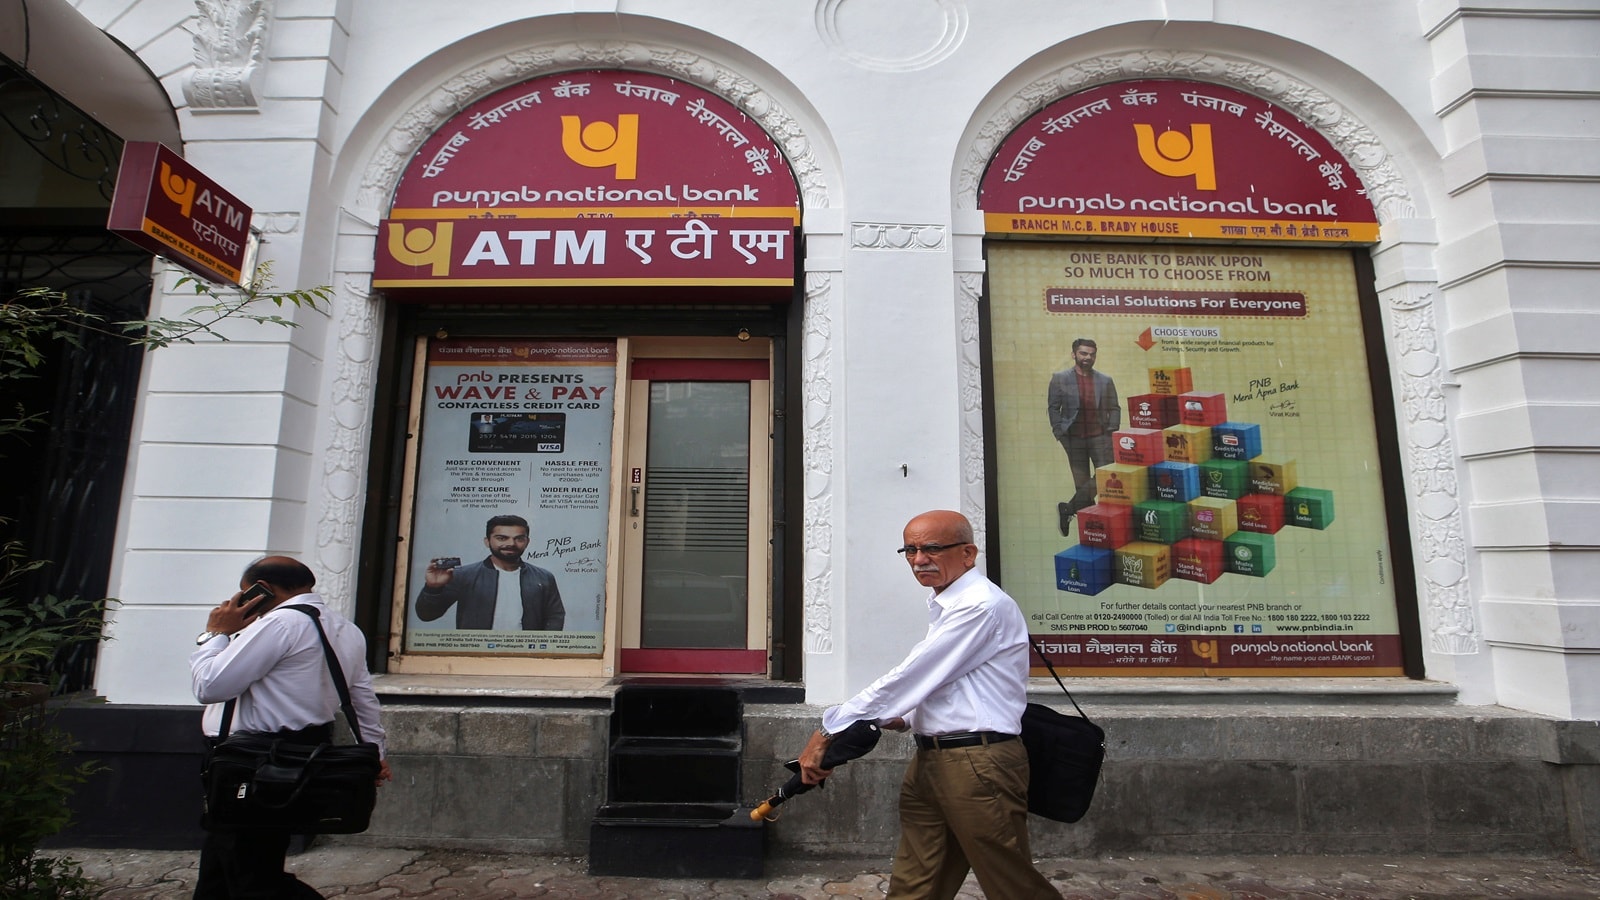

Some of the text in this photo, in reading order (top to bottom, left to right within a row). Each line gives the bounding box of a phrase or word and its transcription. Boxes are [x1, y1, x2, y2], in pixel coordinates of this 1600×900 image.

[422, 131, 470, 180] पंजाब
[552, 80, 591, 98] बँक
[614, 80, 772, 176] पंजाब नैशनल बैंक
[1004, 137, 1046, 184] पंजाब
[1121, 88, 1158, 106] बँक
[1180, 90, 1348, 192] पंजाब नैशनल बैंक
[432, 185, 759, 207] punjab national bank
[196, 189, 244, 231] ATM
[1018, 194, 1338, 216] punjab national bank
[1011, 218, 1179, 234] BRANCH M.C.B. BRADY HOUSE
[1251, 225, 1266, 237] एम
[192, 218, 240, 256] एटीएम
[625, 219, 790, 265] ए टी एम
[151, 225, 178, 245] BRANCH
[197, 250, 216, 267] BRADY
[216, 261, 235, 277] HOUSE
[461, 230, 606, 266] ATM
[1070, 253, 1263, 268] ONE BANK TO BANK UPON
[1064, 266, 1271, 282] SO MUCH TO CHOOSE FROM
[1050, 294, 1302, 312] Financial Solutions For Everyone
[1154, 328, 1218, 338] CHOOSE YOURS
[530, 347, 557, 355] punjab
[457, 371, 584, 385] pnb PRESENTS
[1249, 377, 1273, 392] PNB
[434, 386, 608, 400] WAVE & PAY
[1233, 380, 1300, 404] Mera Apna Bank
[1157, 486, 1178, 494] Trading
[1083, 530, 1107, 538] Housing
[527, 539, 602, 560] Mera Apna Bank
[546, 536, 572, 550] PNB
[1067, 585, 1080, 593] Loan
[1100, 602, 1114, 610] For
[1115, 602, 1141, 610] further
[1169, 603, 1197, 611] contact
[1198, 605, 1215, 613] your
[1266, 603, 1292, 611] branch
[1031, 613, 1044, 621] dial
[1045, 613, 1059, 621] Call
[1144, 614, 1169, 622] (Tolled)
[1204, 614, 1221, 622] India
[1235, 614, 1251, 622] Free
[1177, 624, 1227, 633] @indiapnb
[1277, 624, 1353, 632] www.pnbindia.in
[1086, 638, 1144, 655] नैशनल
[1150, 638, 1177, 654] बैंक
[1231, 641, 1373, 656] punjab national bank
